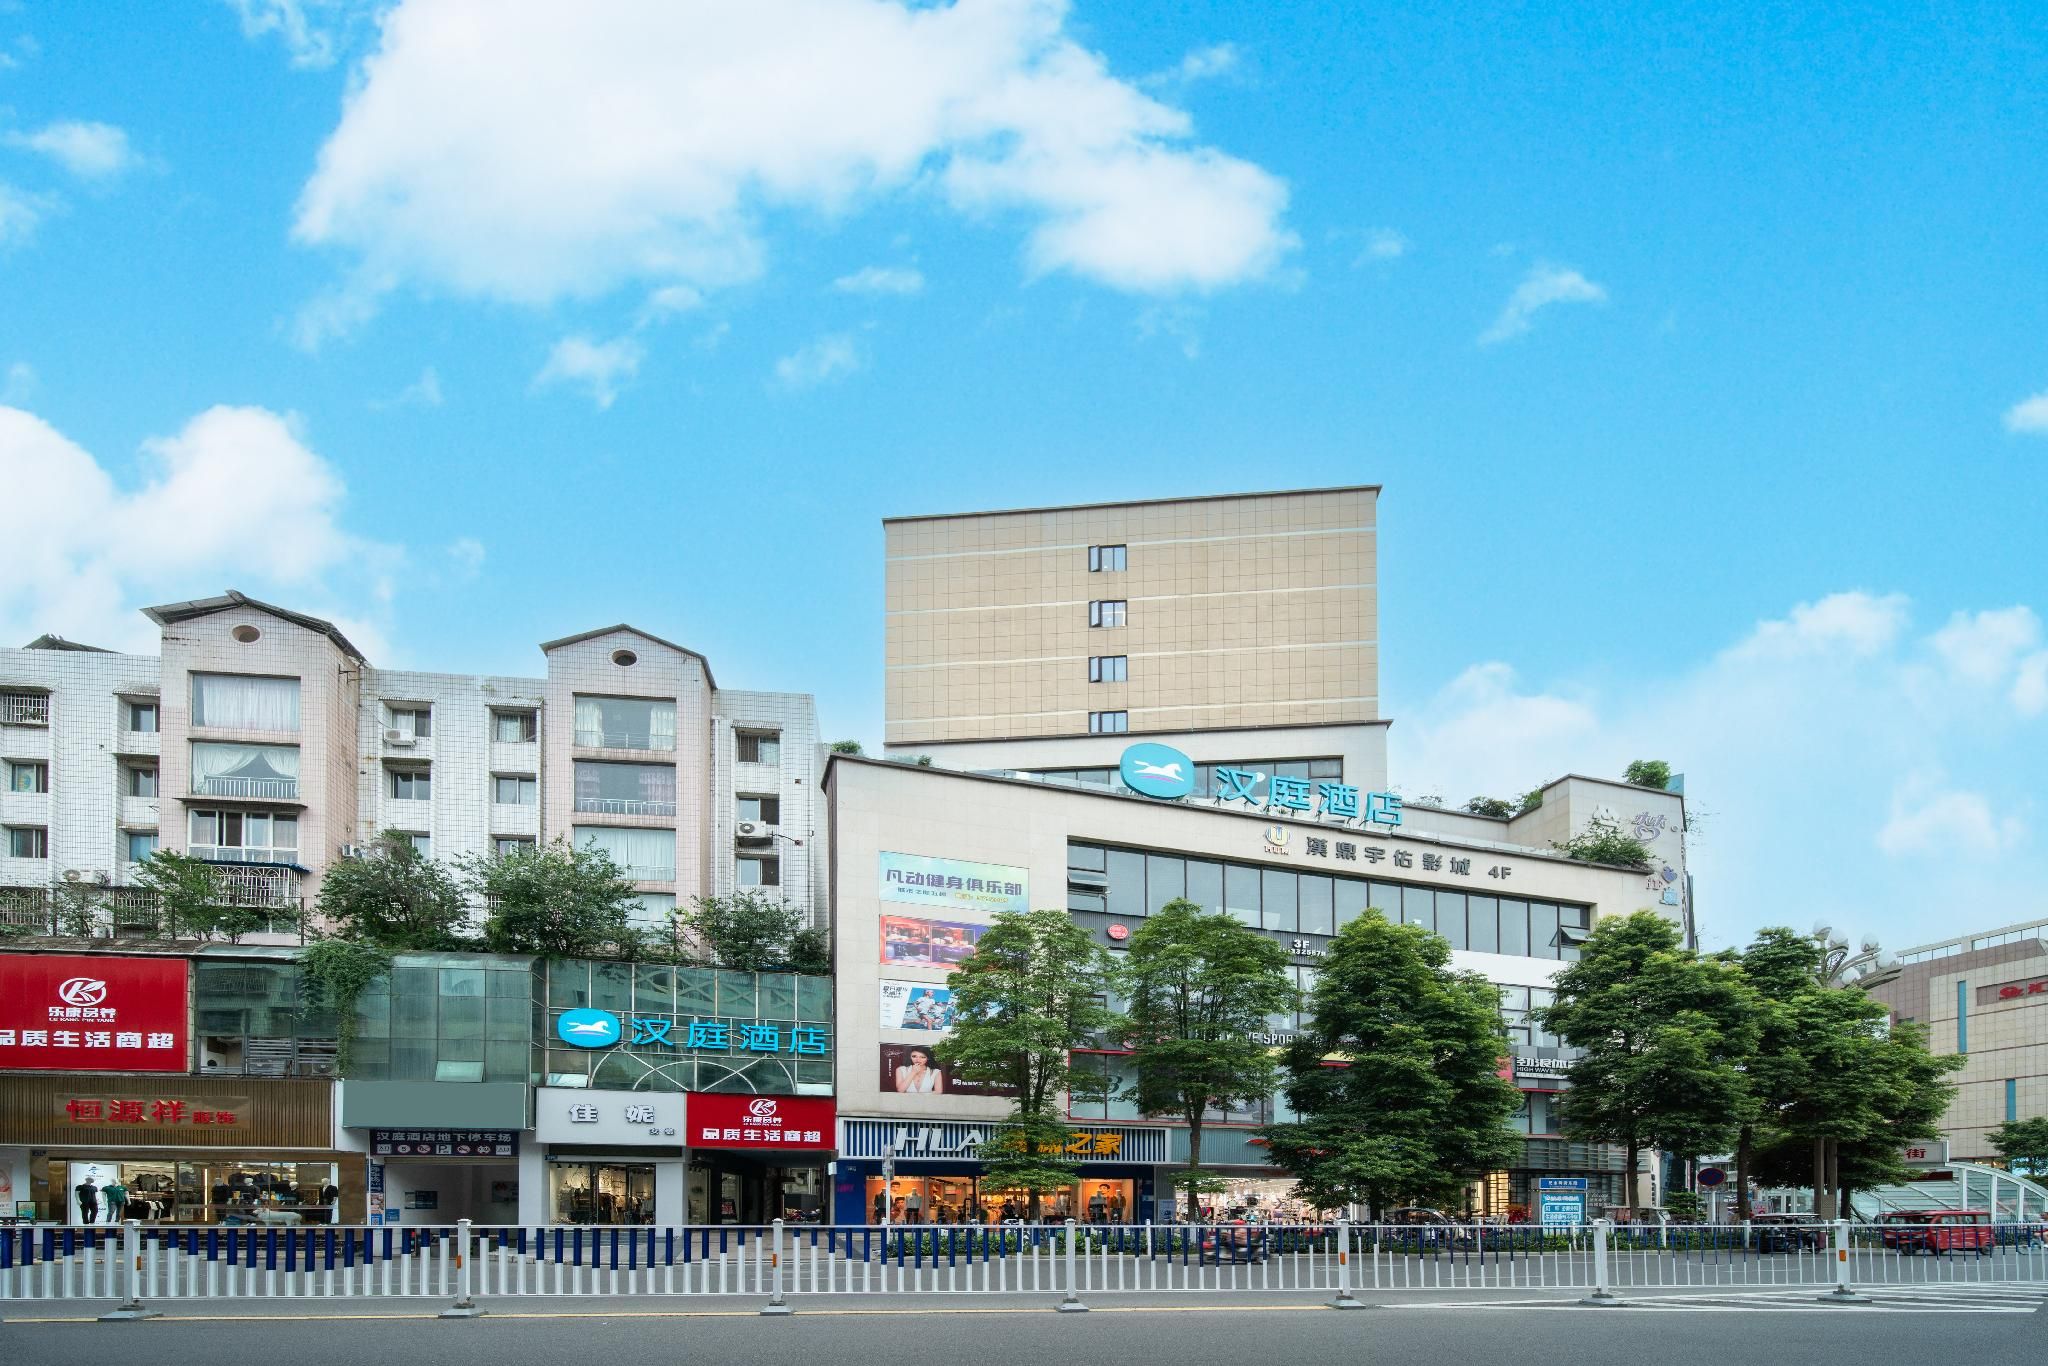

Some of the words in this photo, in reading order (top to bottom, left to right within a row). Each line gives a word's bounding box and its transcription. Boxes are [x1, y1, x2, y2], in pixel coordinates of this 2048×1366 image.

[1216, 766, 1402, 826] 汉庭酒店
[1306, 836, 1470, 876] 漢鼎宇佑影城
[1488, 865, 1512, 880] 4F
[886, 868, 1022, 896] 凡动健身俱乐部
[1293, 939, 1310, 949] 3F
[48, 1006, 117, 1019] 乐康品养
[0, 1029, 174, 1049] 品质生活商超
[631, 1017, 826, 1055] 汉庭酒店
[65, 1099, 189, 1124] 恒源祥
[569, 1104, 655, 1124] 佳妮
[376, 1132, 512, 1143] 汉庭酒店地下停车场
[702, 1128, 821, 1143] 品质生活商超
[894, 1127, 987, 1153] HLA
[1905, 1147, 1926, 1160] 街
